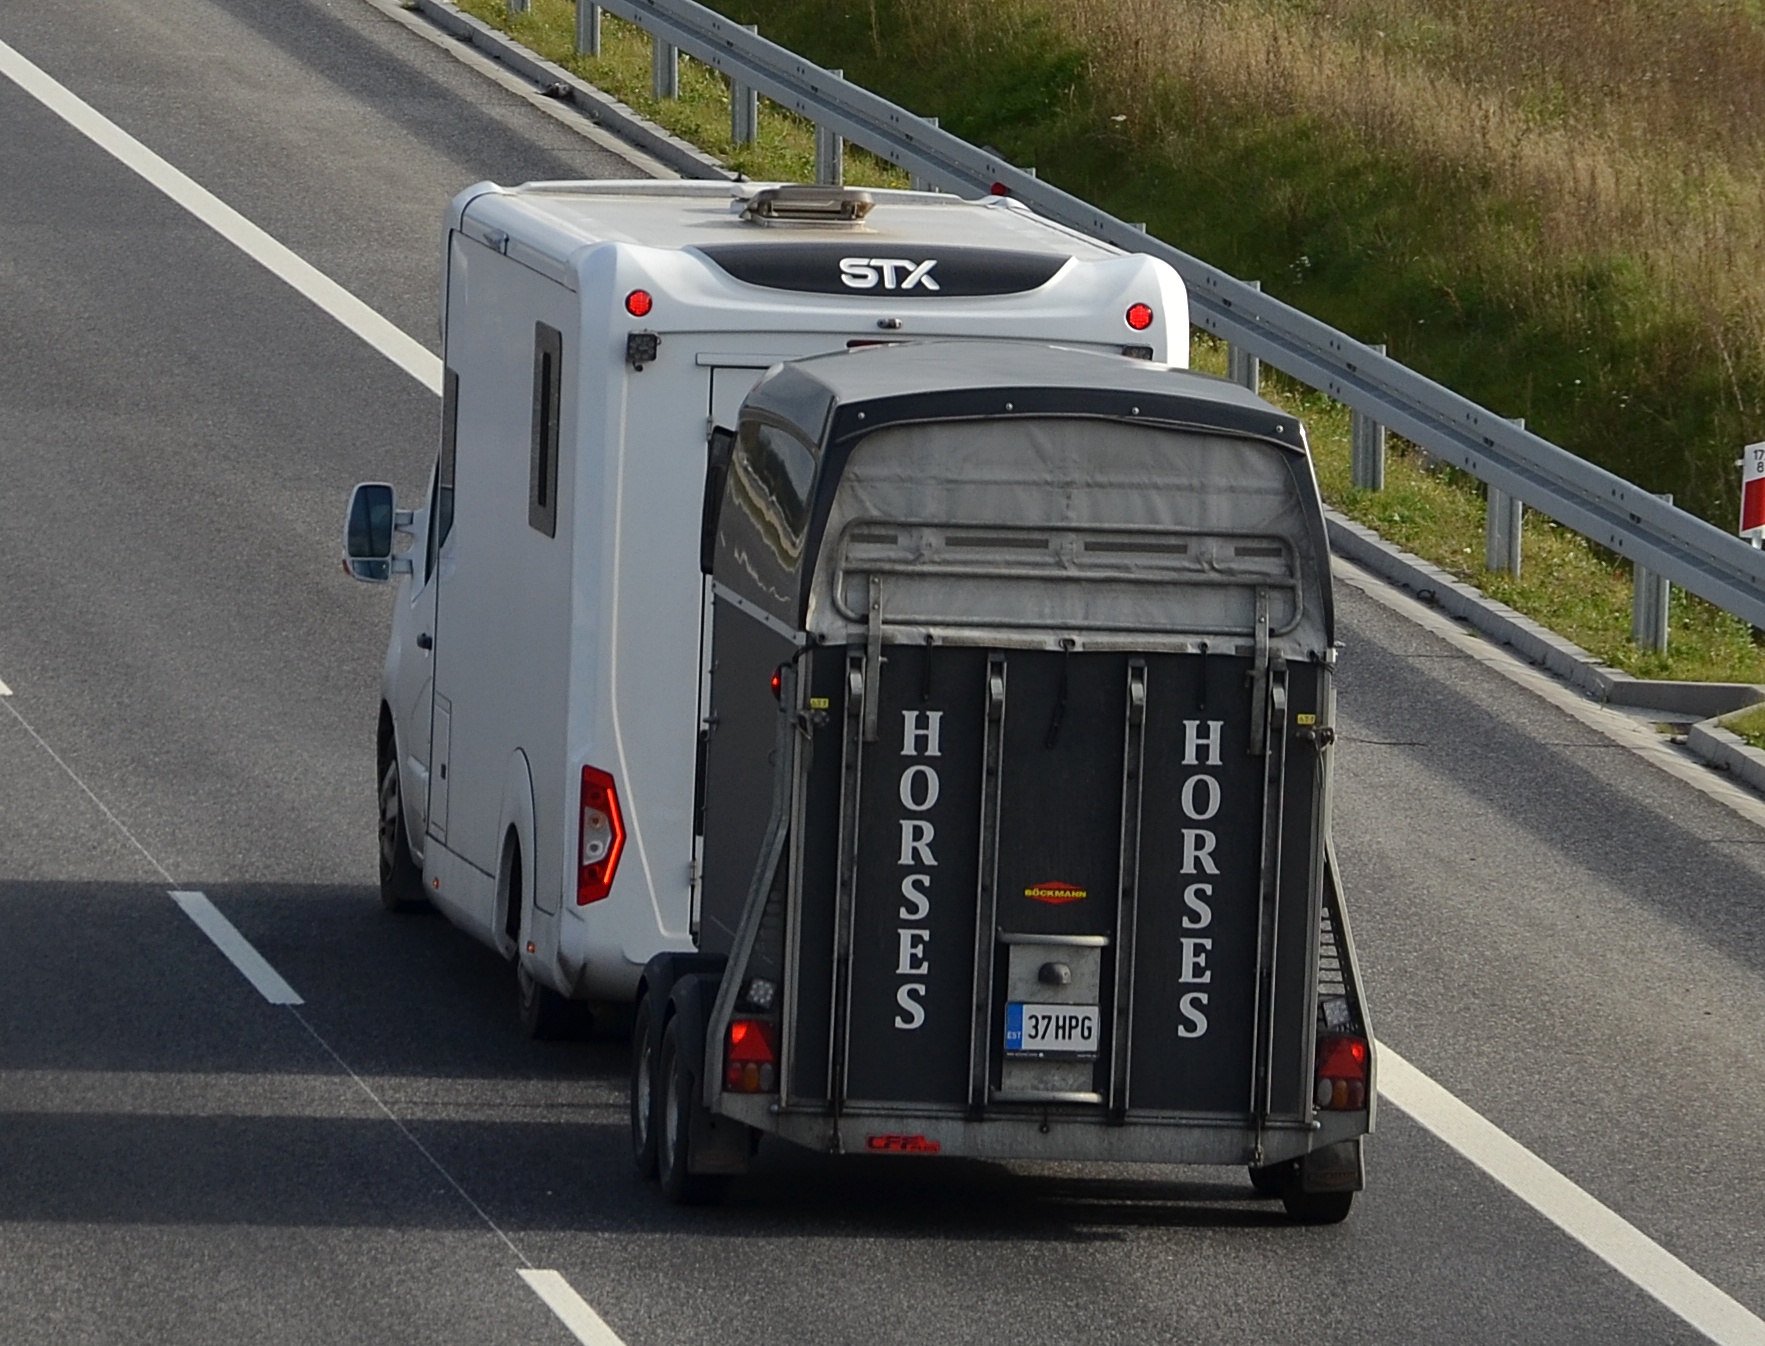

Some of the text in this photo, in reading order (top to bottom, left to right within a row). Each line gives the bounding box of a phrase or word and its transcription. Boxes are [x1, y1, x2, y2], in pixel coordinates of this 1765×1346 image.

[839, 257, 941, 290] STX
[894, 710, 944, 1030] HORSES
[1177, 719, 1225, 1038] HORSES
[1024, 888, 1087, 898] BÖCKMANN
[1007, 1014, 1093, 1041] EST 37HPG
